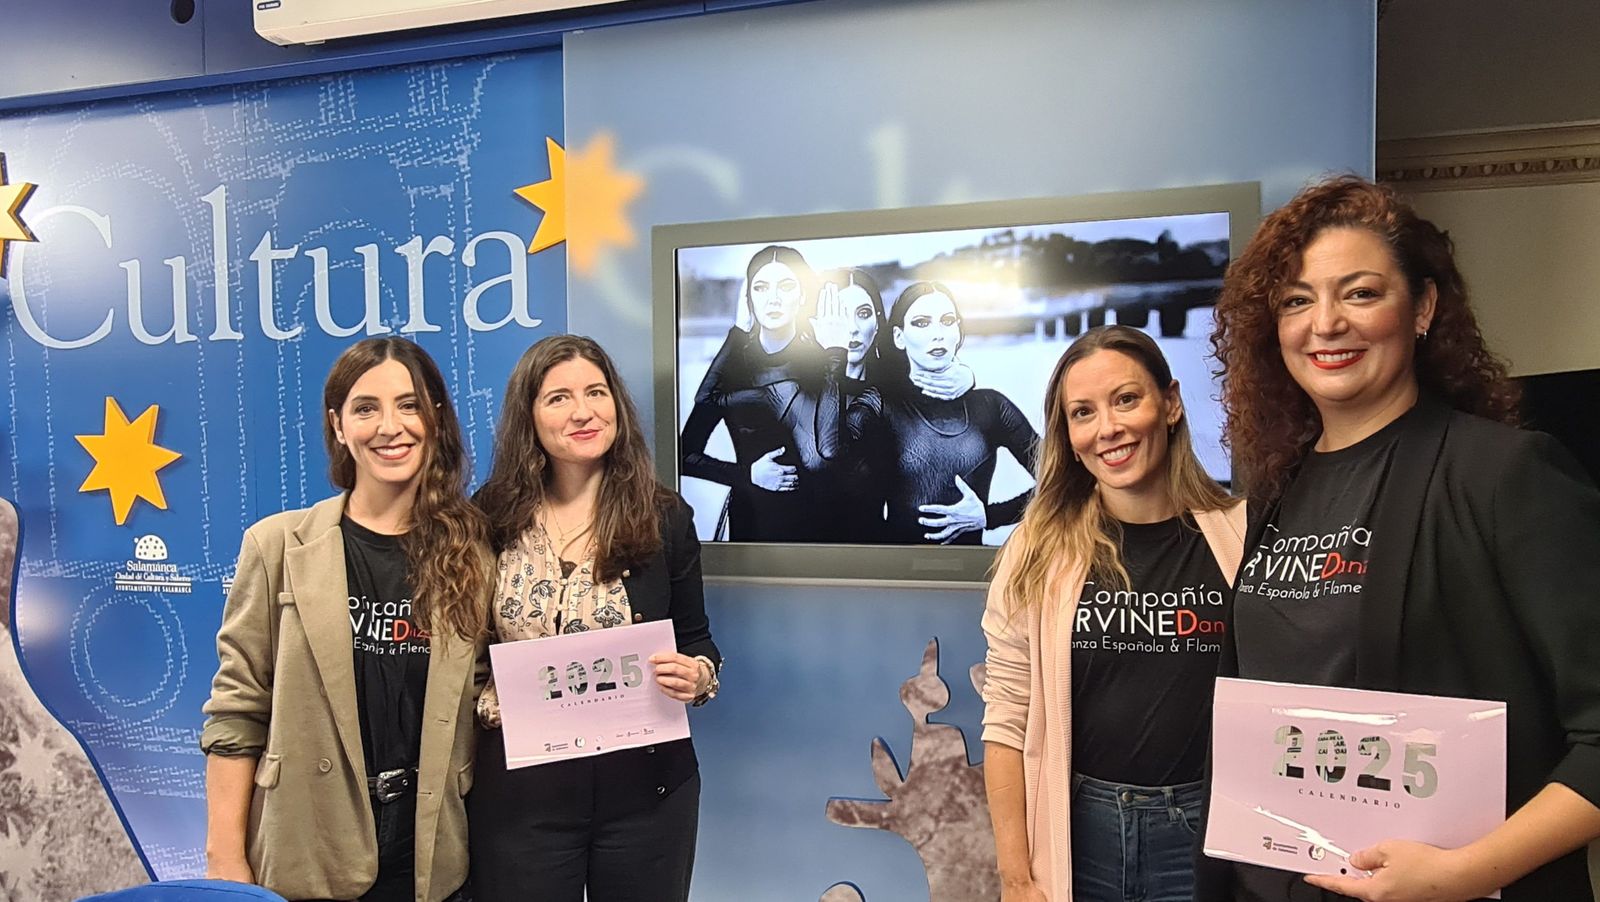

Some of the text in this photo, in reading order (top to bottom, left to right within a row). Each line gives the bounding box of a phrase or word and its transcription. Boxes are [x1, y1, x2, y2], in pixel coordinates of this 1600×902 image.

[9, 185, 542, 349] Cultura
[1260, 519, 1372, 553] ompaña
[162, 586, 192, 594] SALAMANCA
[1323, 580, 1362, 596] Flame
[1073, 607, 1225, 636] RVINEDan
[1072, 636, 1221, 654] nza Española & Flam
[538, 653, 643, 701] 2025
[561, 694, 625, 709] CALENDARIO
[1272, 725, 1438, 799] 2025
[1298, 788, 1401, 809] CALENDARIO
